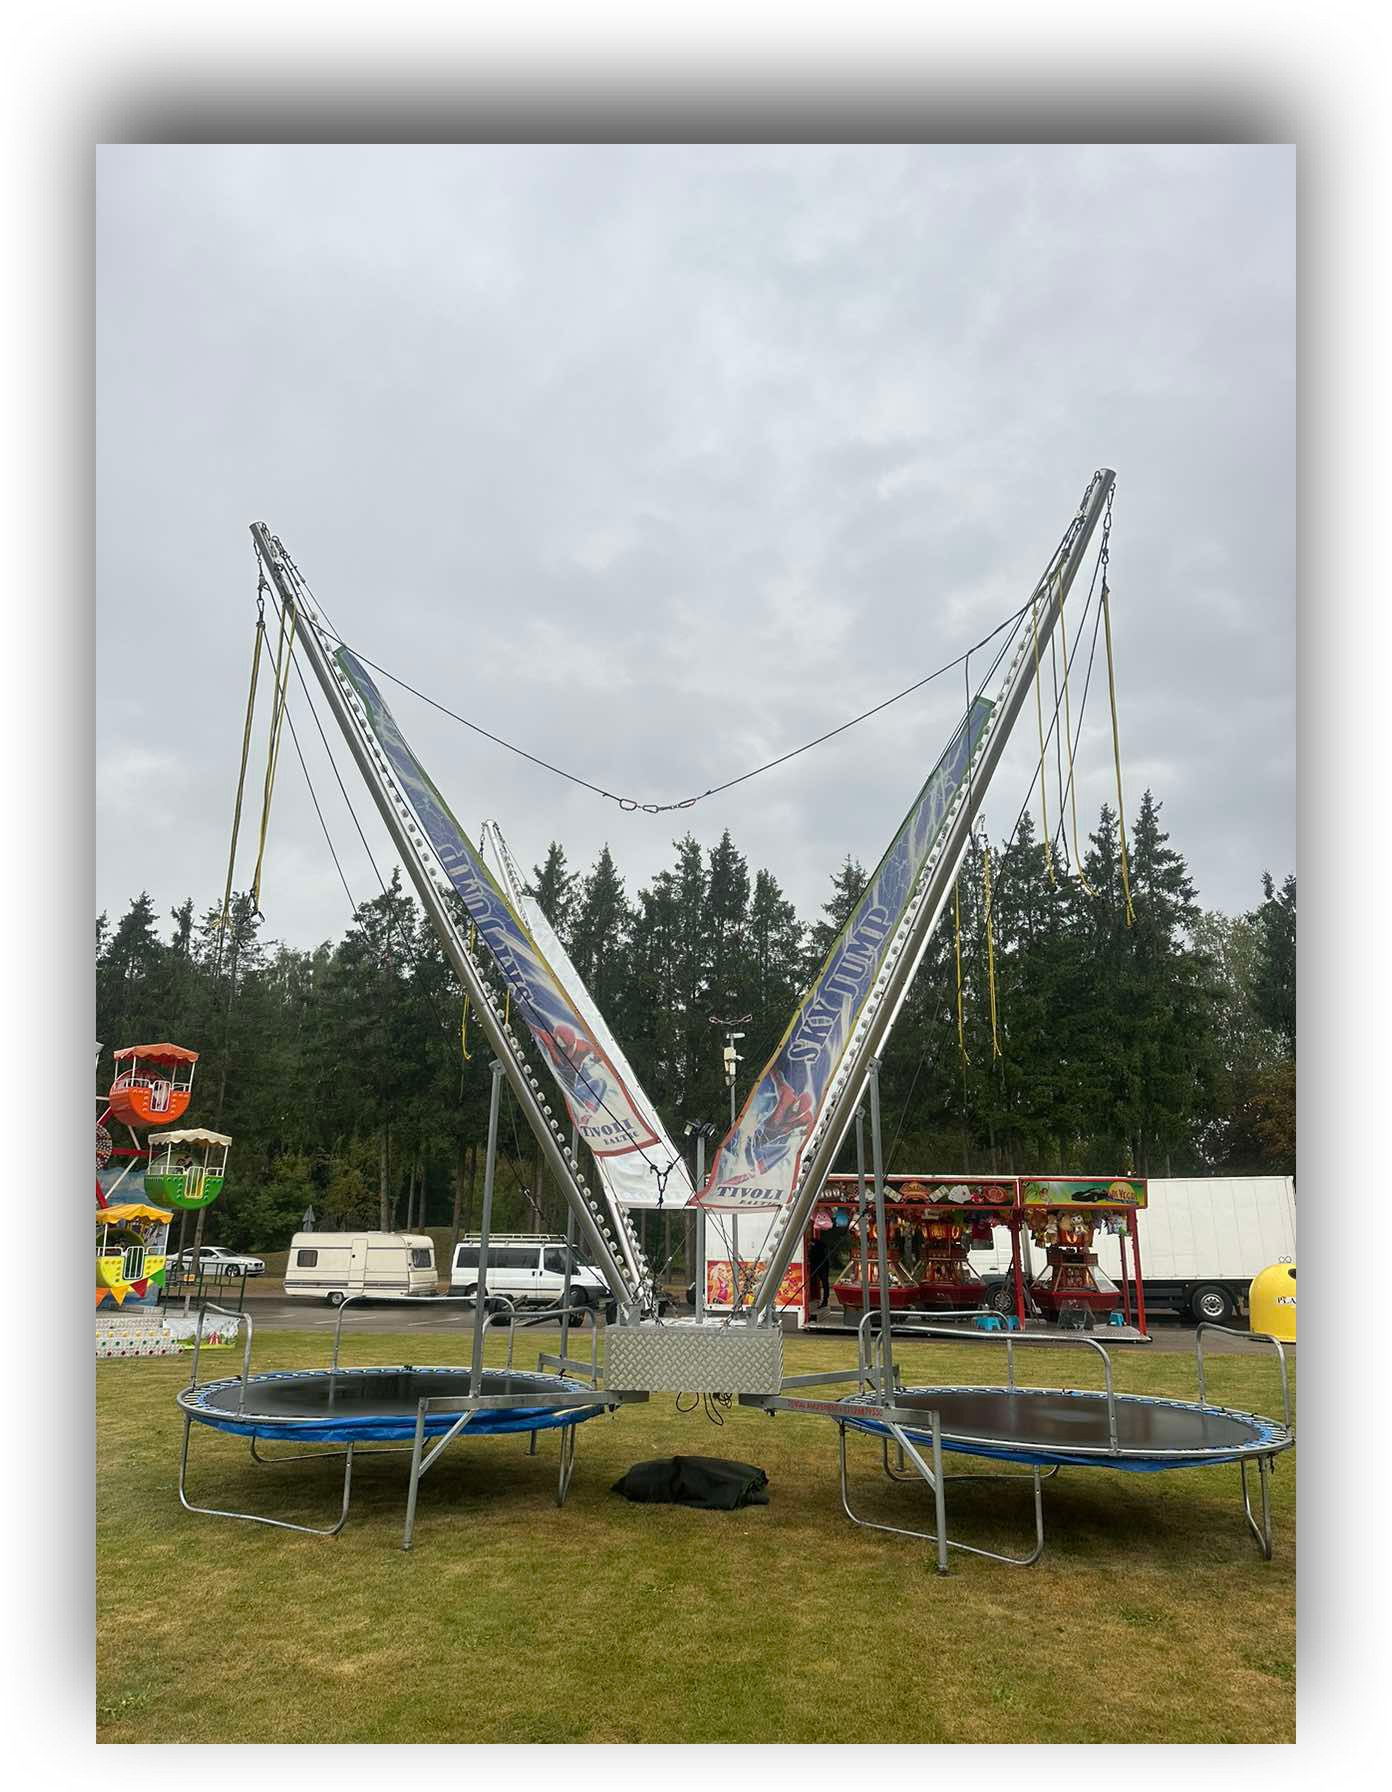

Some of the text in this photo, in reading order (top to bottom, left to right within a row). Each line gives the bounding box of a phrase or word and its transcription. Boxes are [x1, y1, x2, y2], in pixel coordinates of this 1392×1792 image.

[438, 843, 507, 934] JUMP
[787, 905, 893, 1064] SKY JUMP
[717, 1186, 784, 1200] TIVOLI
